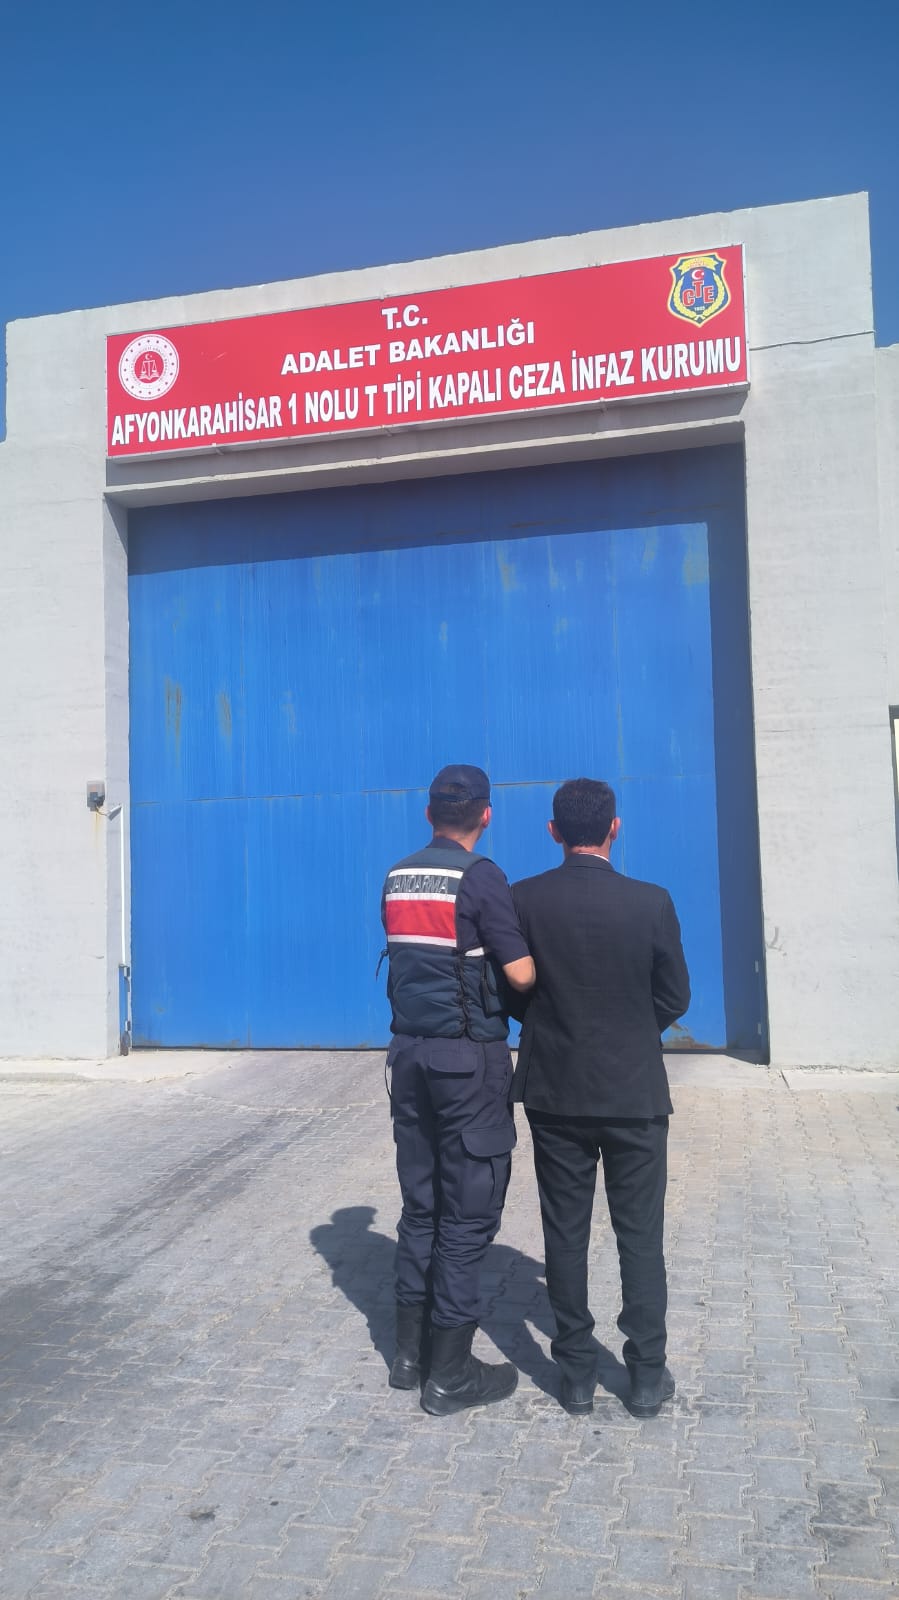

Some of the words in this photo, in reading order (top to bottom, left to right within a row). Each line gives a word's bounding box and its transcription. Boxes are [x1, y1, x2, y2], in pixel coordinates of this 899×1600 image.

[381, 304, 429, 330] T.C.
[280, 344, 381, 376] ADALET
[389, 319, 535, 363] BAKANLIĞI
[111, 392, 282, 446] AFYONKARAHİSAR
[288, 393, 298, 426] 1
[305, 387, 359, 424] NOLU
[364, 384, 378, 417] T
[383, 371, 422, 415] TİPİ
[428, 366, 502, 409] KAPALI
[508, 360, 566, 400] CEZA
[571, 350, 635, 392] İNFAZ
[641, 336, 742, 383] KURUMU
[390, 875, 449, 894] JANDARMA
